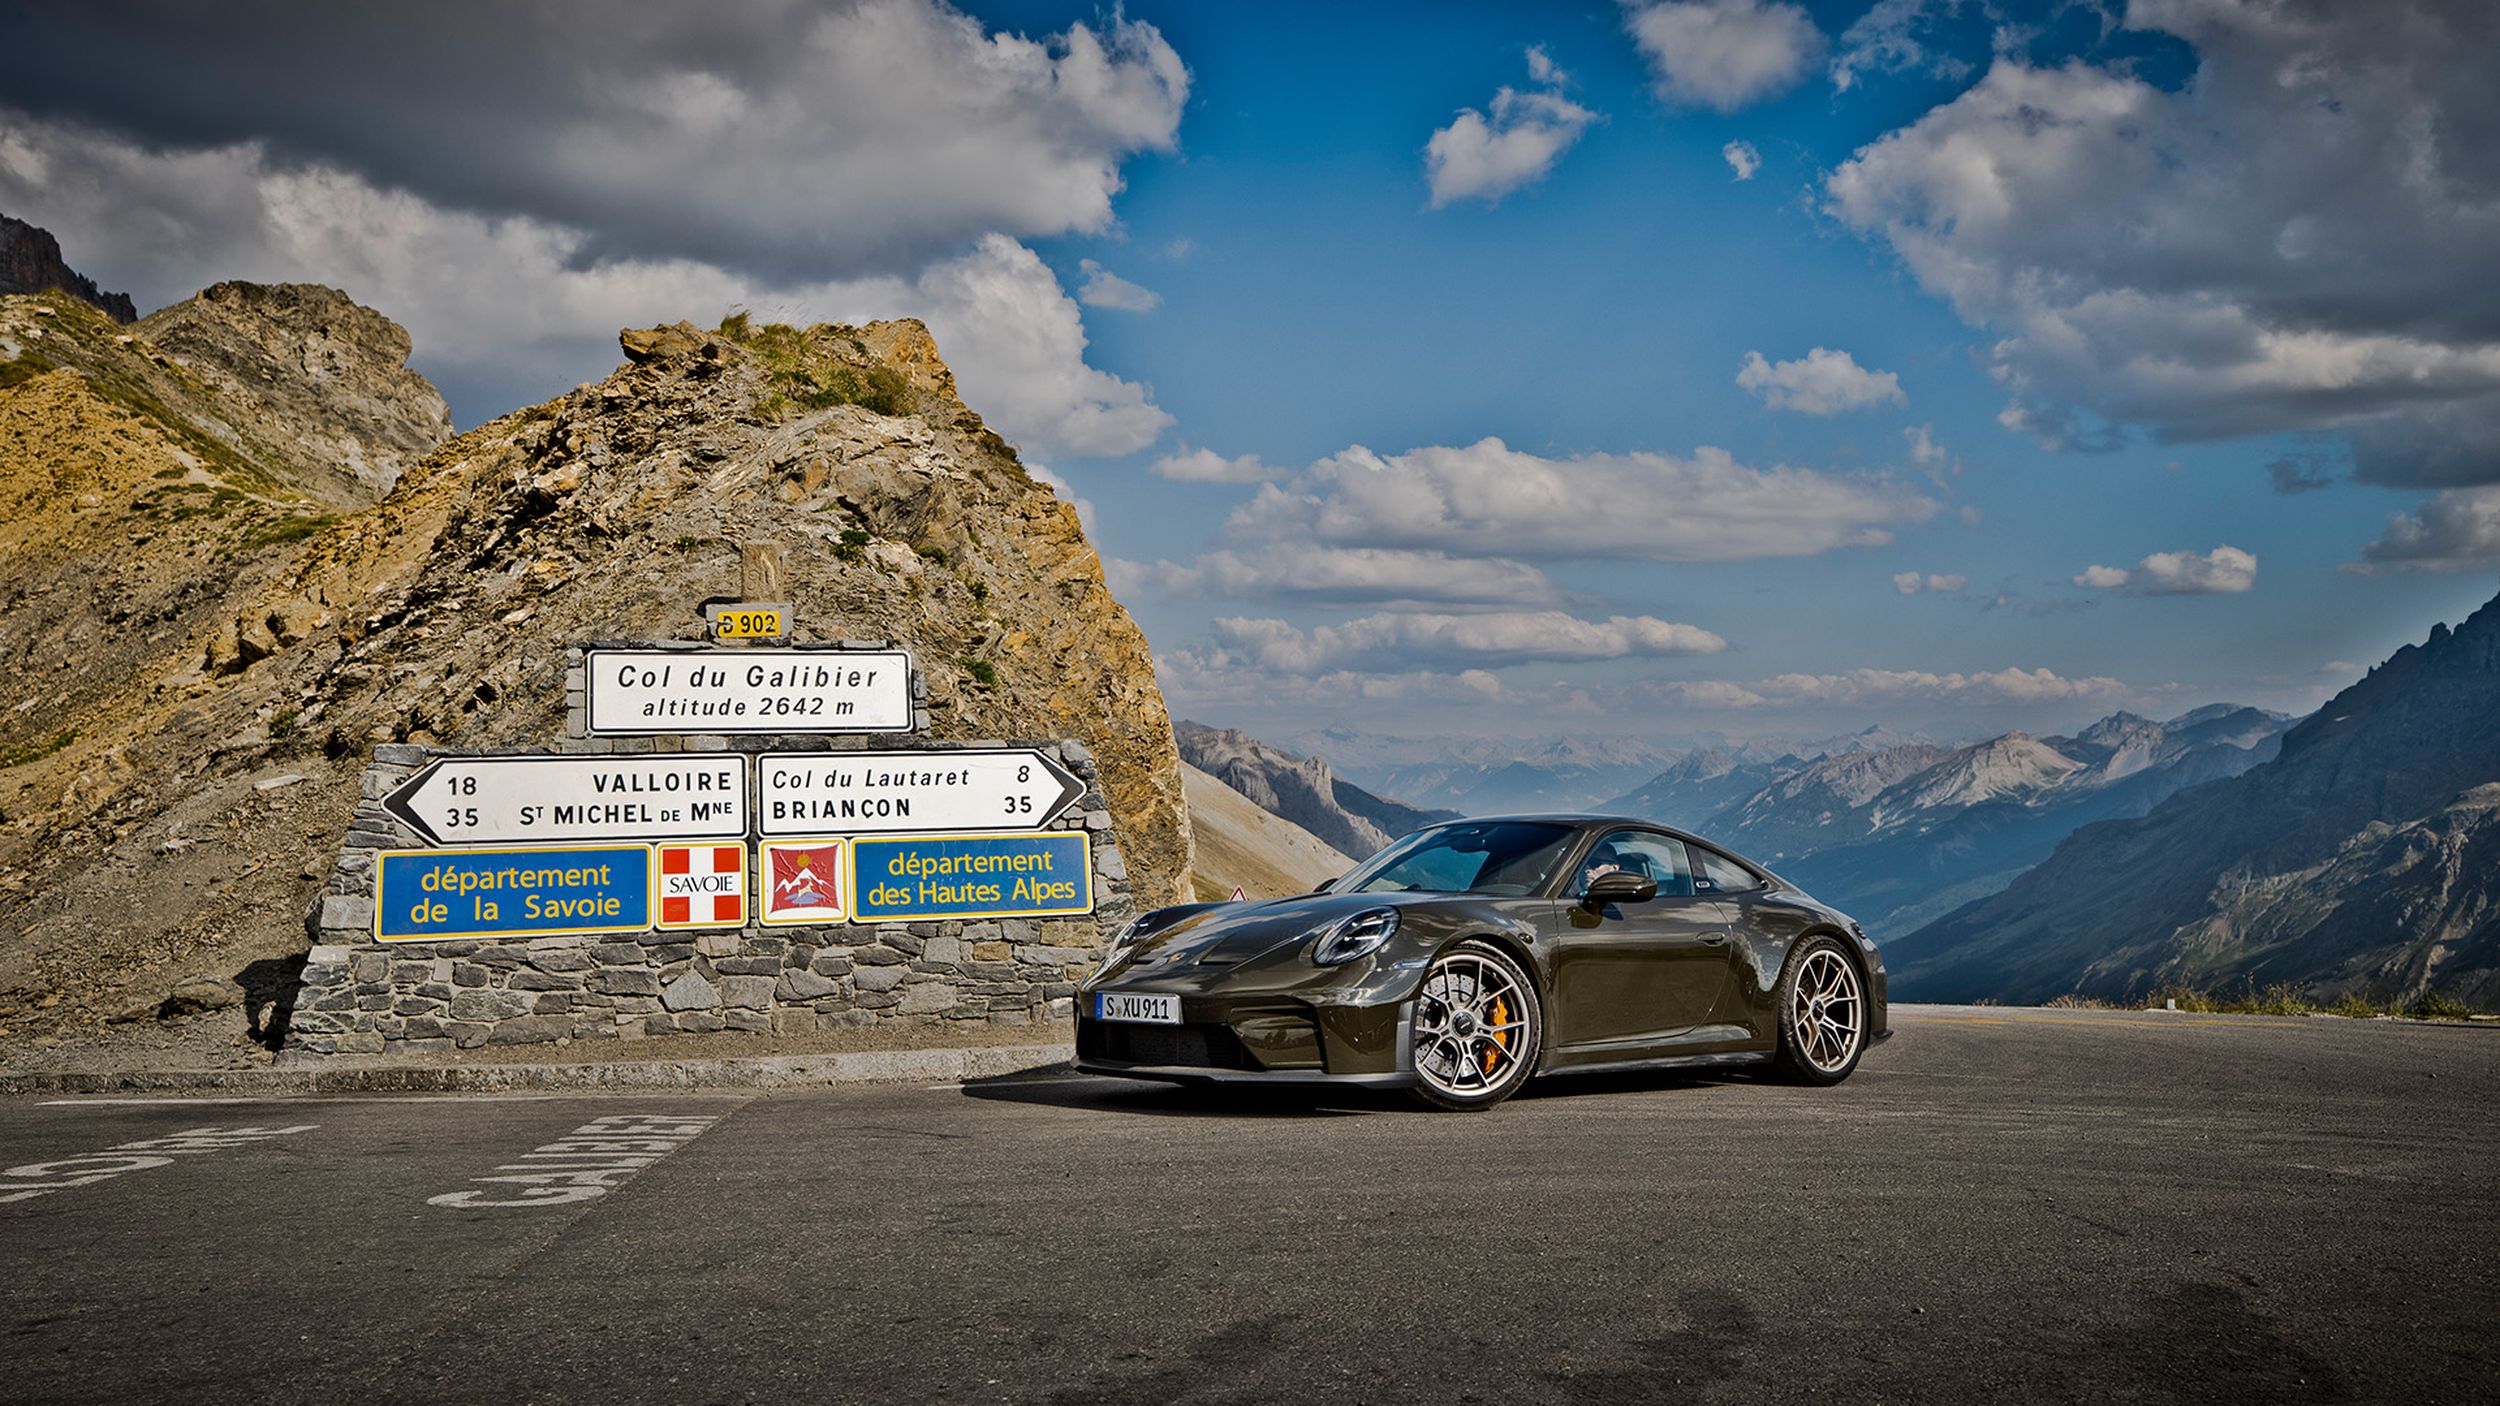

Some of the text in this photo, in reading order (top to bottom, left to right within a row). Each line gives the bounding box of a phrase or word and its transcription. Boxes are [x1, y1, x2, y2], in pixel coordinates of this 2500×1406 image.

[723, 614, 776, 633] D 902
[618, 664, 878, 688] Col du Galibier
[643, 697, 855, 717] altitude 2642 m
[447, 772, 731, 796] 18 VALLOIRE
[772, 764, 1030, 789] Col du Lautaret 8
[446, 807, 479, 828] 35
[553, 804, 652, 825] MICHEL
[773, 796, 1033, 820] BRIANÇON 35
[888, 850, 1054, 879] département
[421, 863, 611, 895] département
[669, 875, 733, 893] SAVOIE
[868, 877, 1076, 906] des Hautes Alpes
[410, 892, 621, 924] de la Savoie
[1106, 997, 1114, 1017] S
[1142, 998, 1169, 1019] 911
[427, 1114, 719, 1208] GALIBIER
